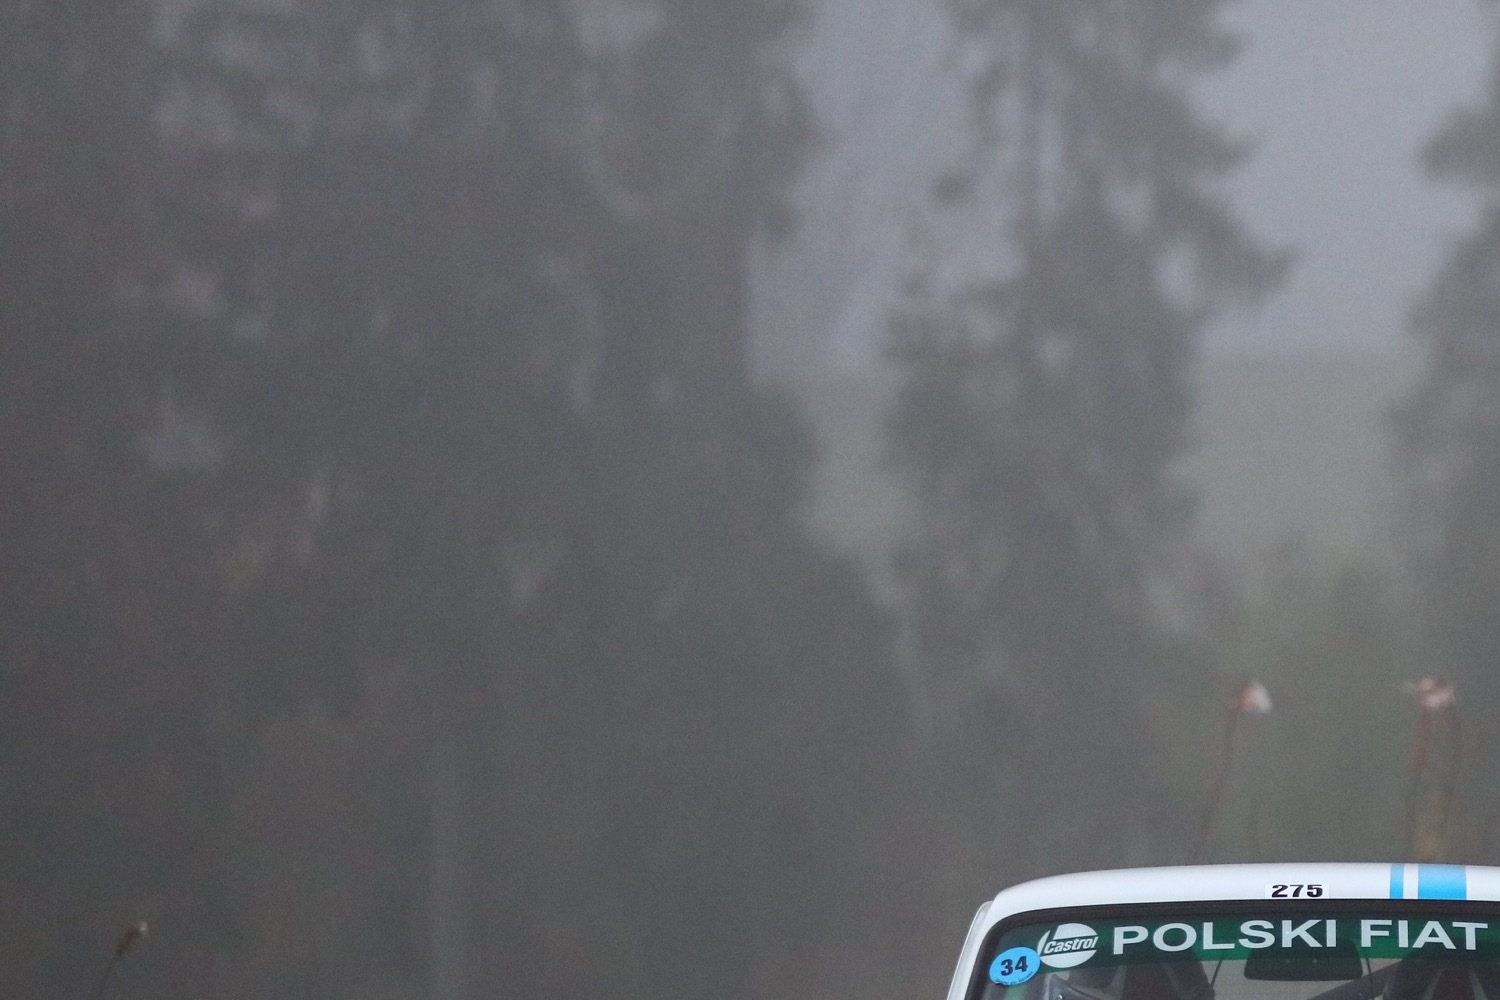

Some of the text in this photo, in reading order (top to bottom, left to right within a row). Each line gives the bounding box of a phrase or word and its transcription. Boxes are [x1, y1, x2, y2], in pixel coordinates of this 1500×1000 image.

[1271, 884, 1323, 898] 275
[1043, 936, 1099, 954] Castrol
[1112, 919, 1489, 955] POLSKI FIAT
[1000, 955, 1028, 977] 34
